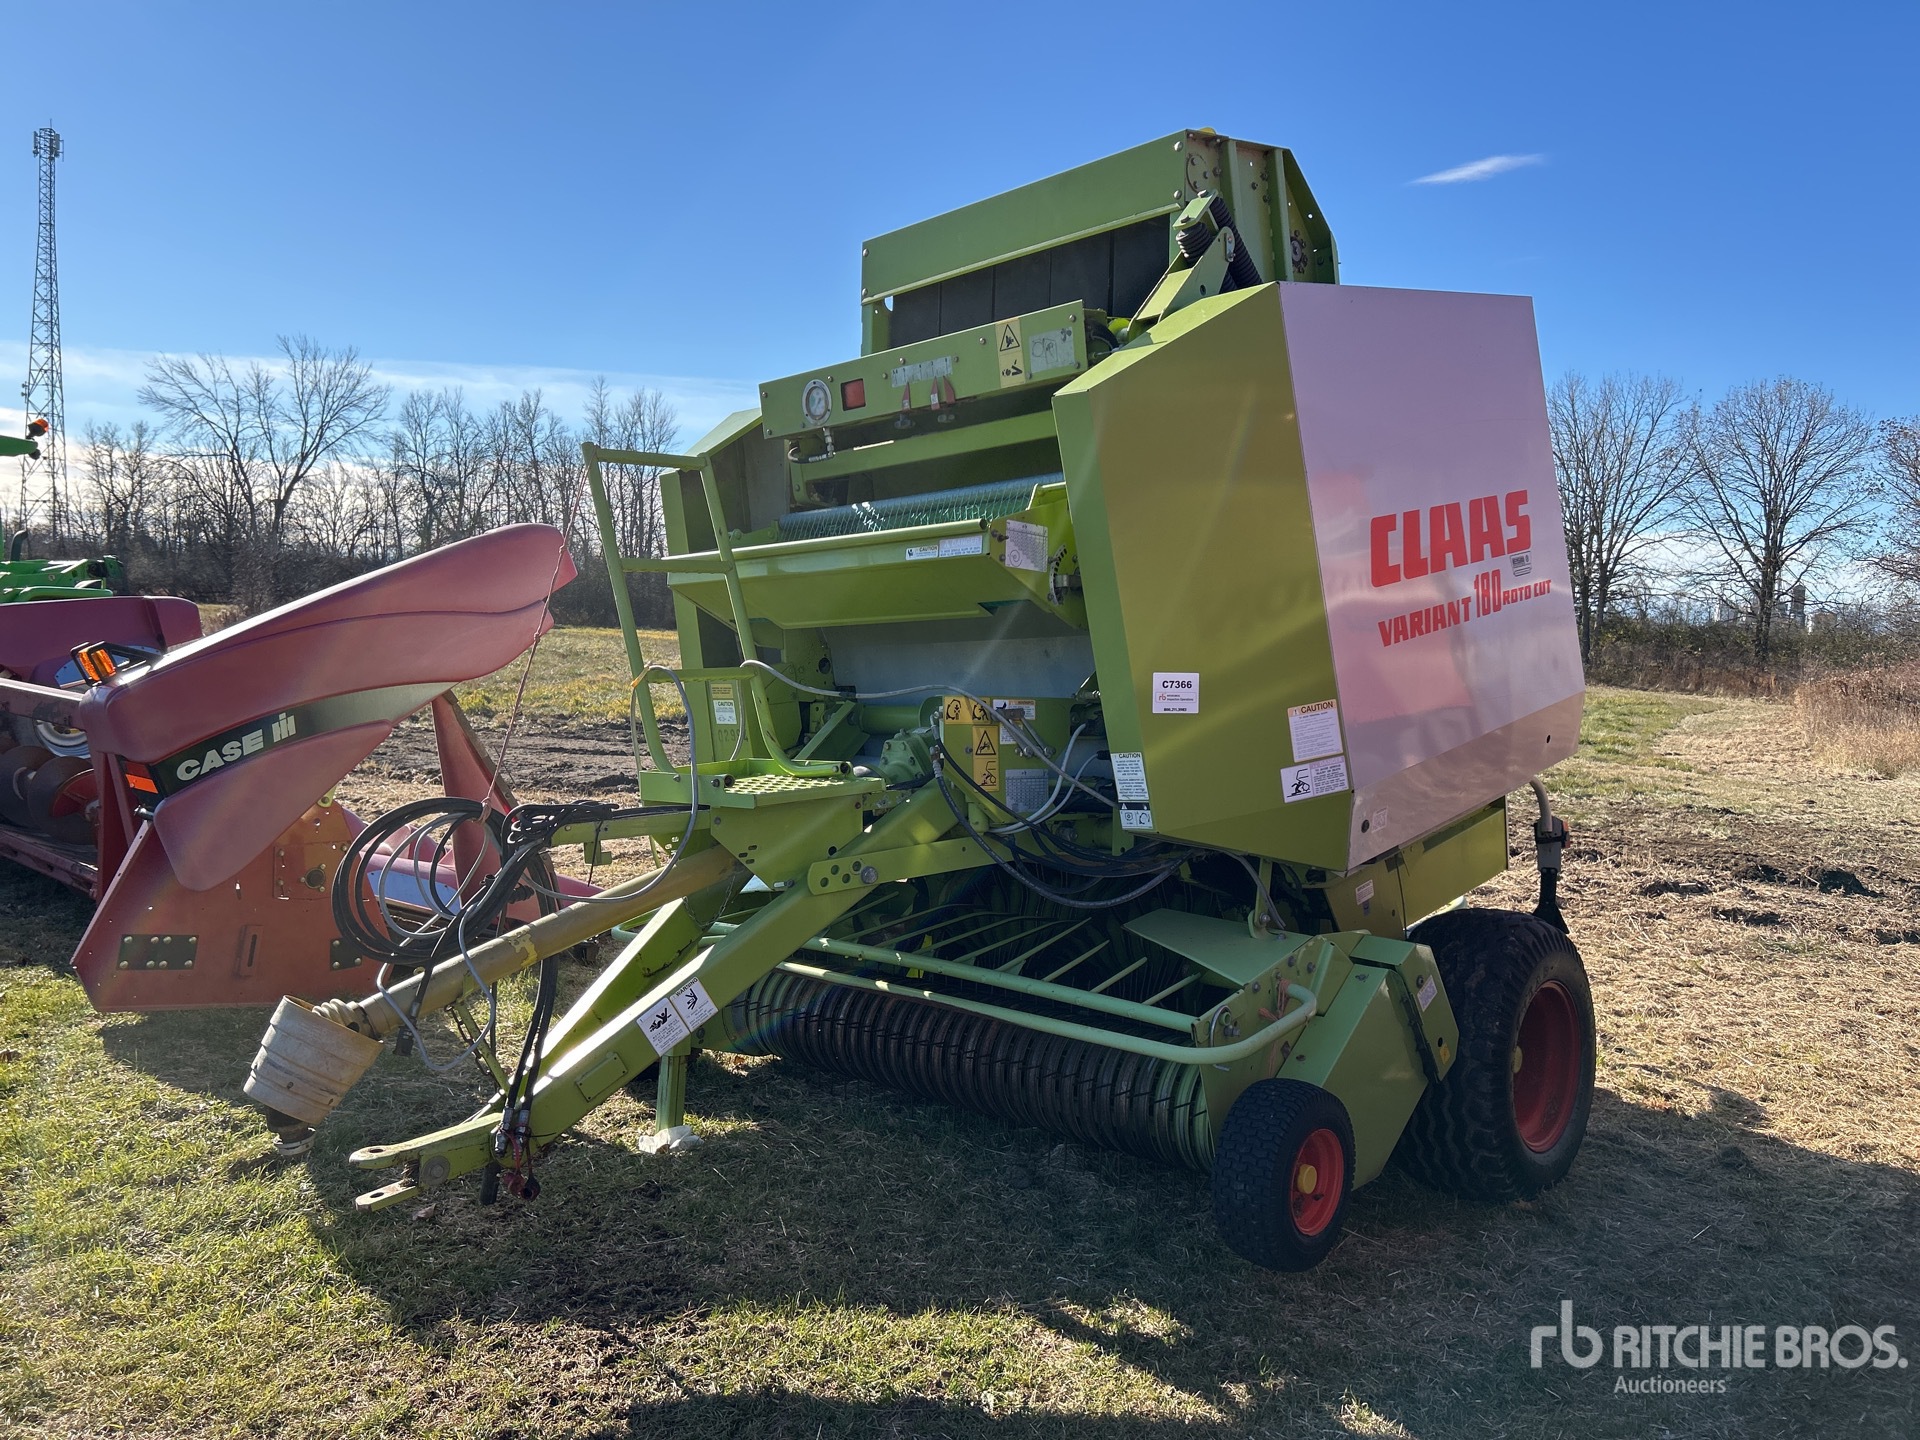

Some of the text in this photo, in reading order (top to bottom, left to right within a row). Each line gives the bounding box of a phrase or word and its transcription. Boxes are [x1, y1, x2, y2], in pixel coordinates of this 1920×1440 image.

[1370, 489, 1532, 588] CLAAS
[1378, 569, 1552, 648] VARIANT 180 ROTO CUT
[1162, 680, 1193, 689] C7366
[1301, 701, 1334, 714] CAUTION
[176, 728, 264, 781] CASE
[675, 977, 698, 997] WARNING
